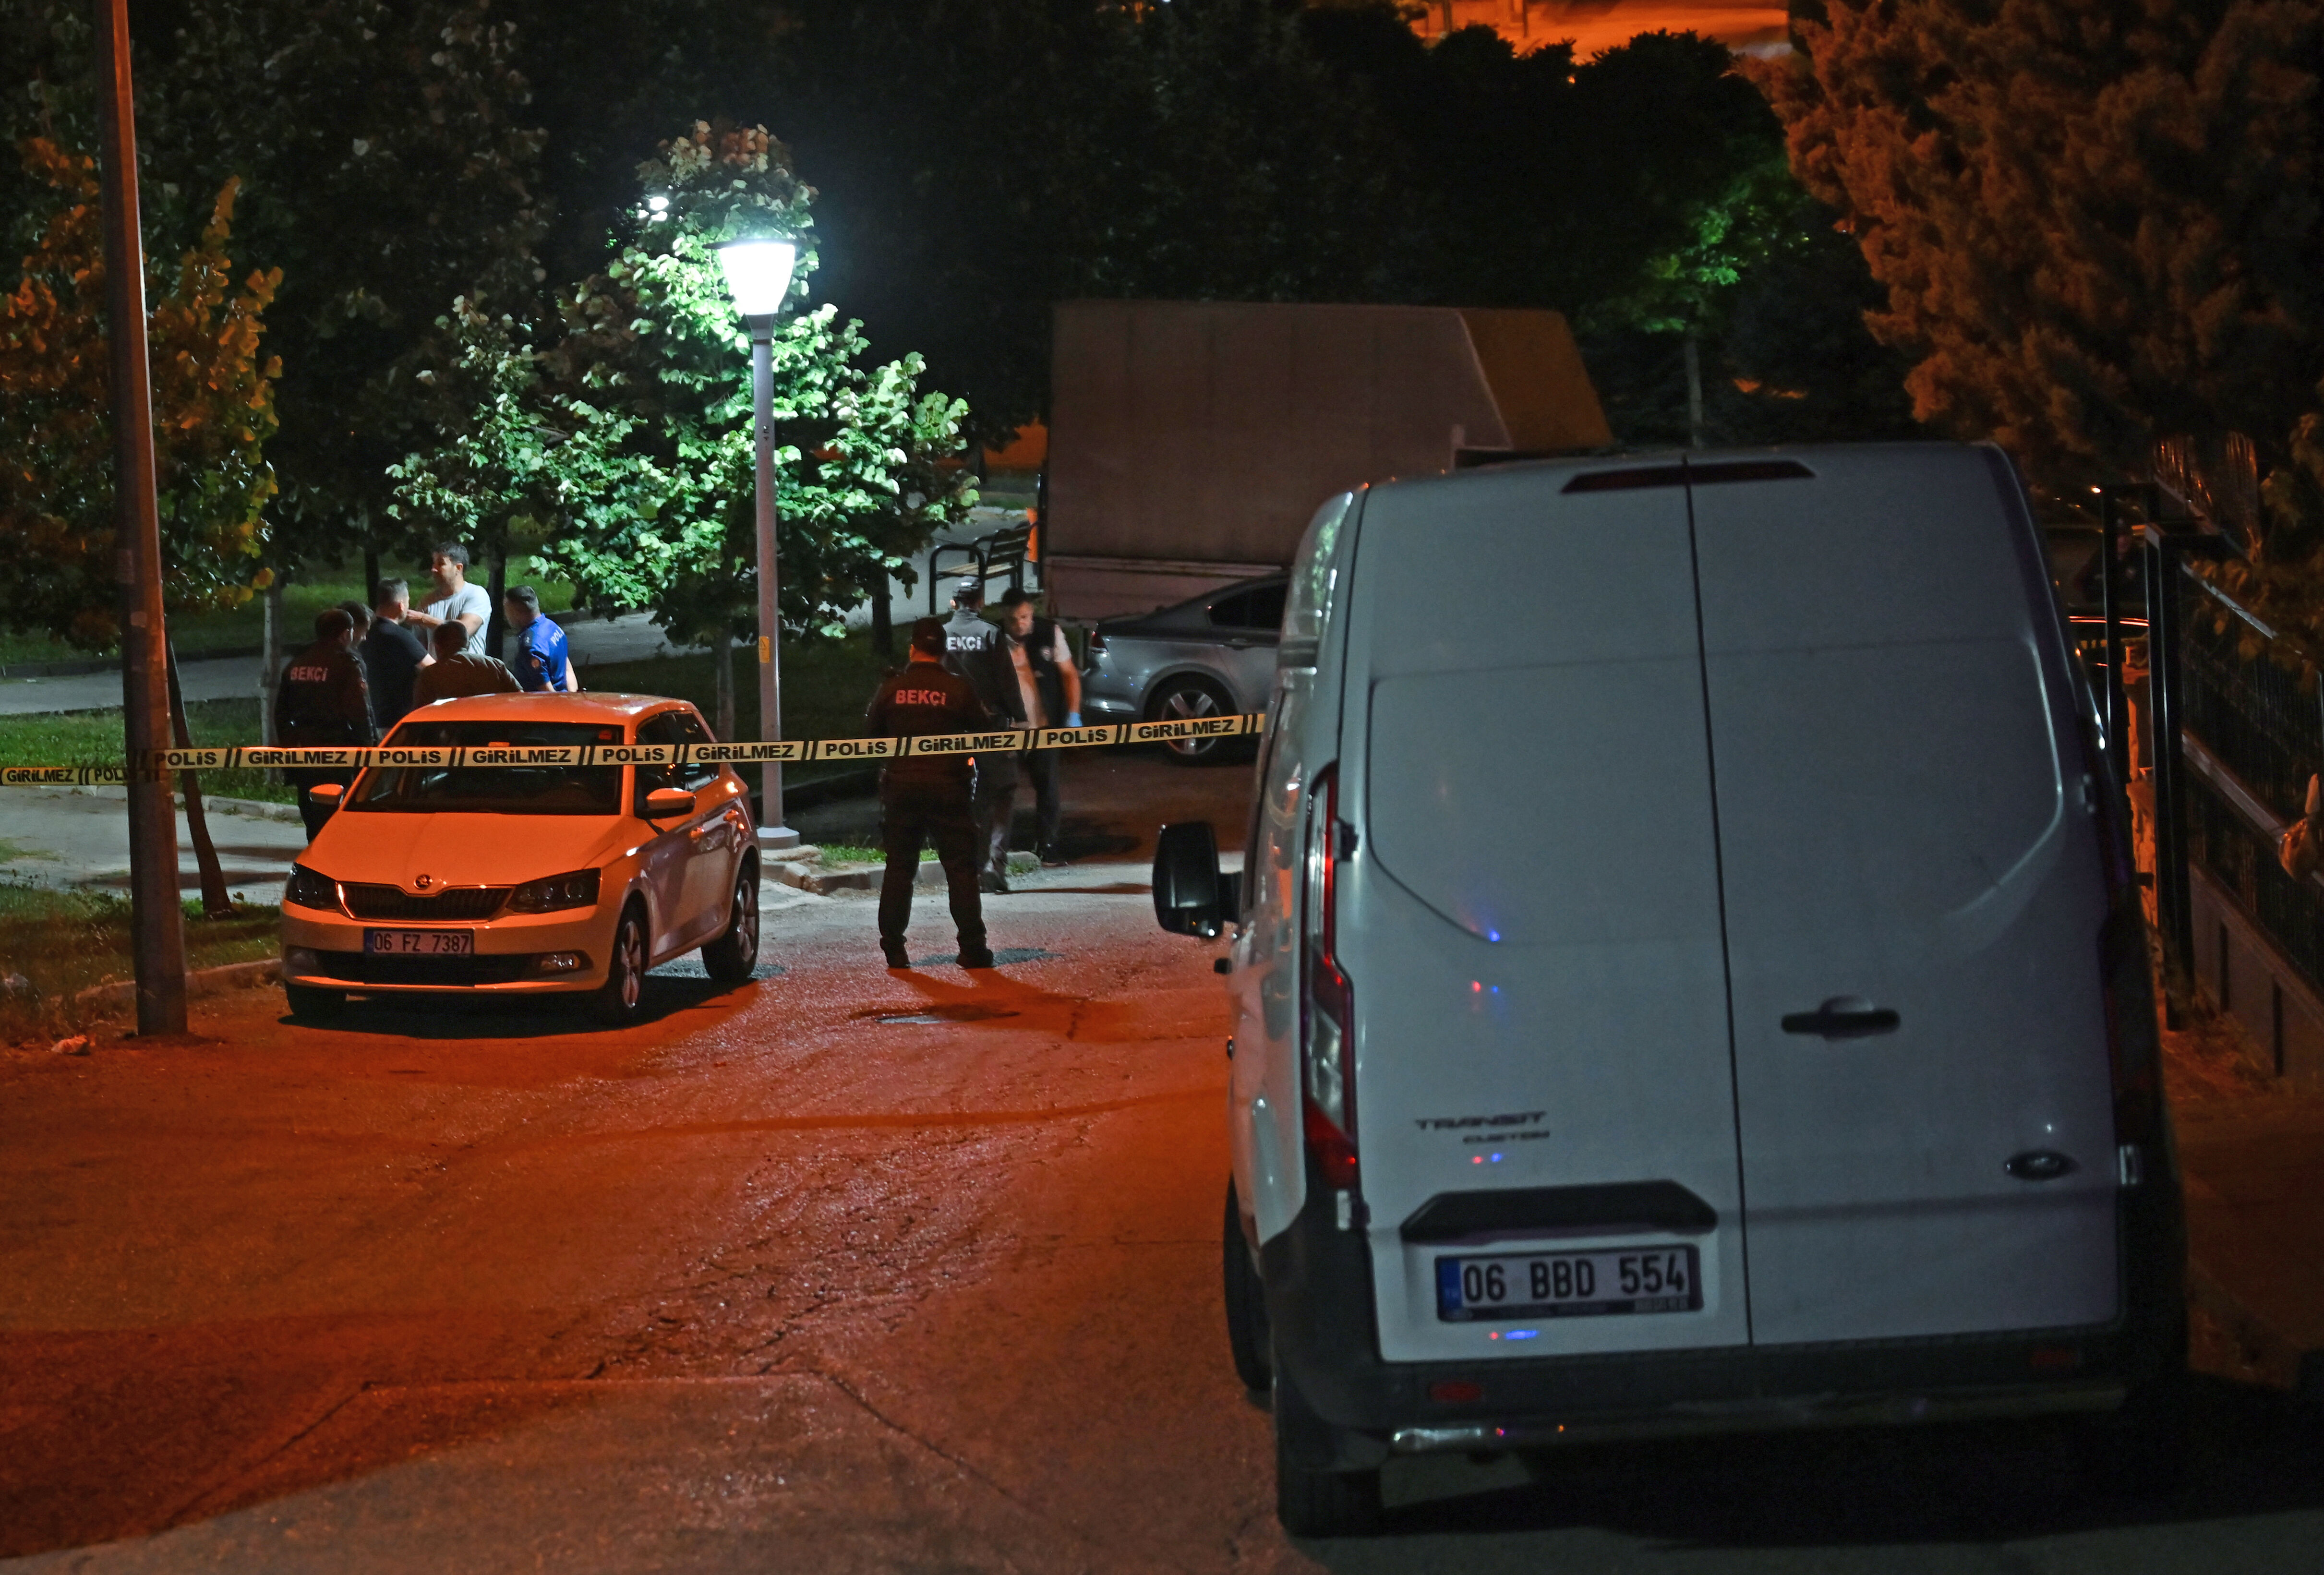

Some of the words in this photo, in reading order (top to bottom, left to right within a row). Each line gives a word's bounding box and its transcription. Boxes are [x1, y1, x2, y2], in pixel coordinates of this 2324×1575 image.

[946, 636, 982, 650] EKÇİ
[374, 933, 392, 951] 06
[402, 934, 421, 951] FZ
[432, 935, 470, 952] 7387
[1415, 1110, 1547, 1130] TRANSIT
[1464, 1264, 1505, 1301] 06
[1530, 1260, 1595, 1299] BBD
[1619, 1253, 1684, 1294] 554
